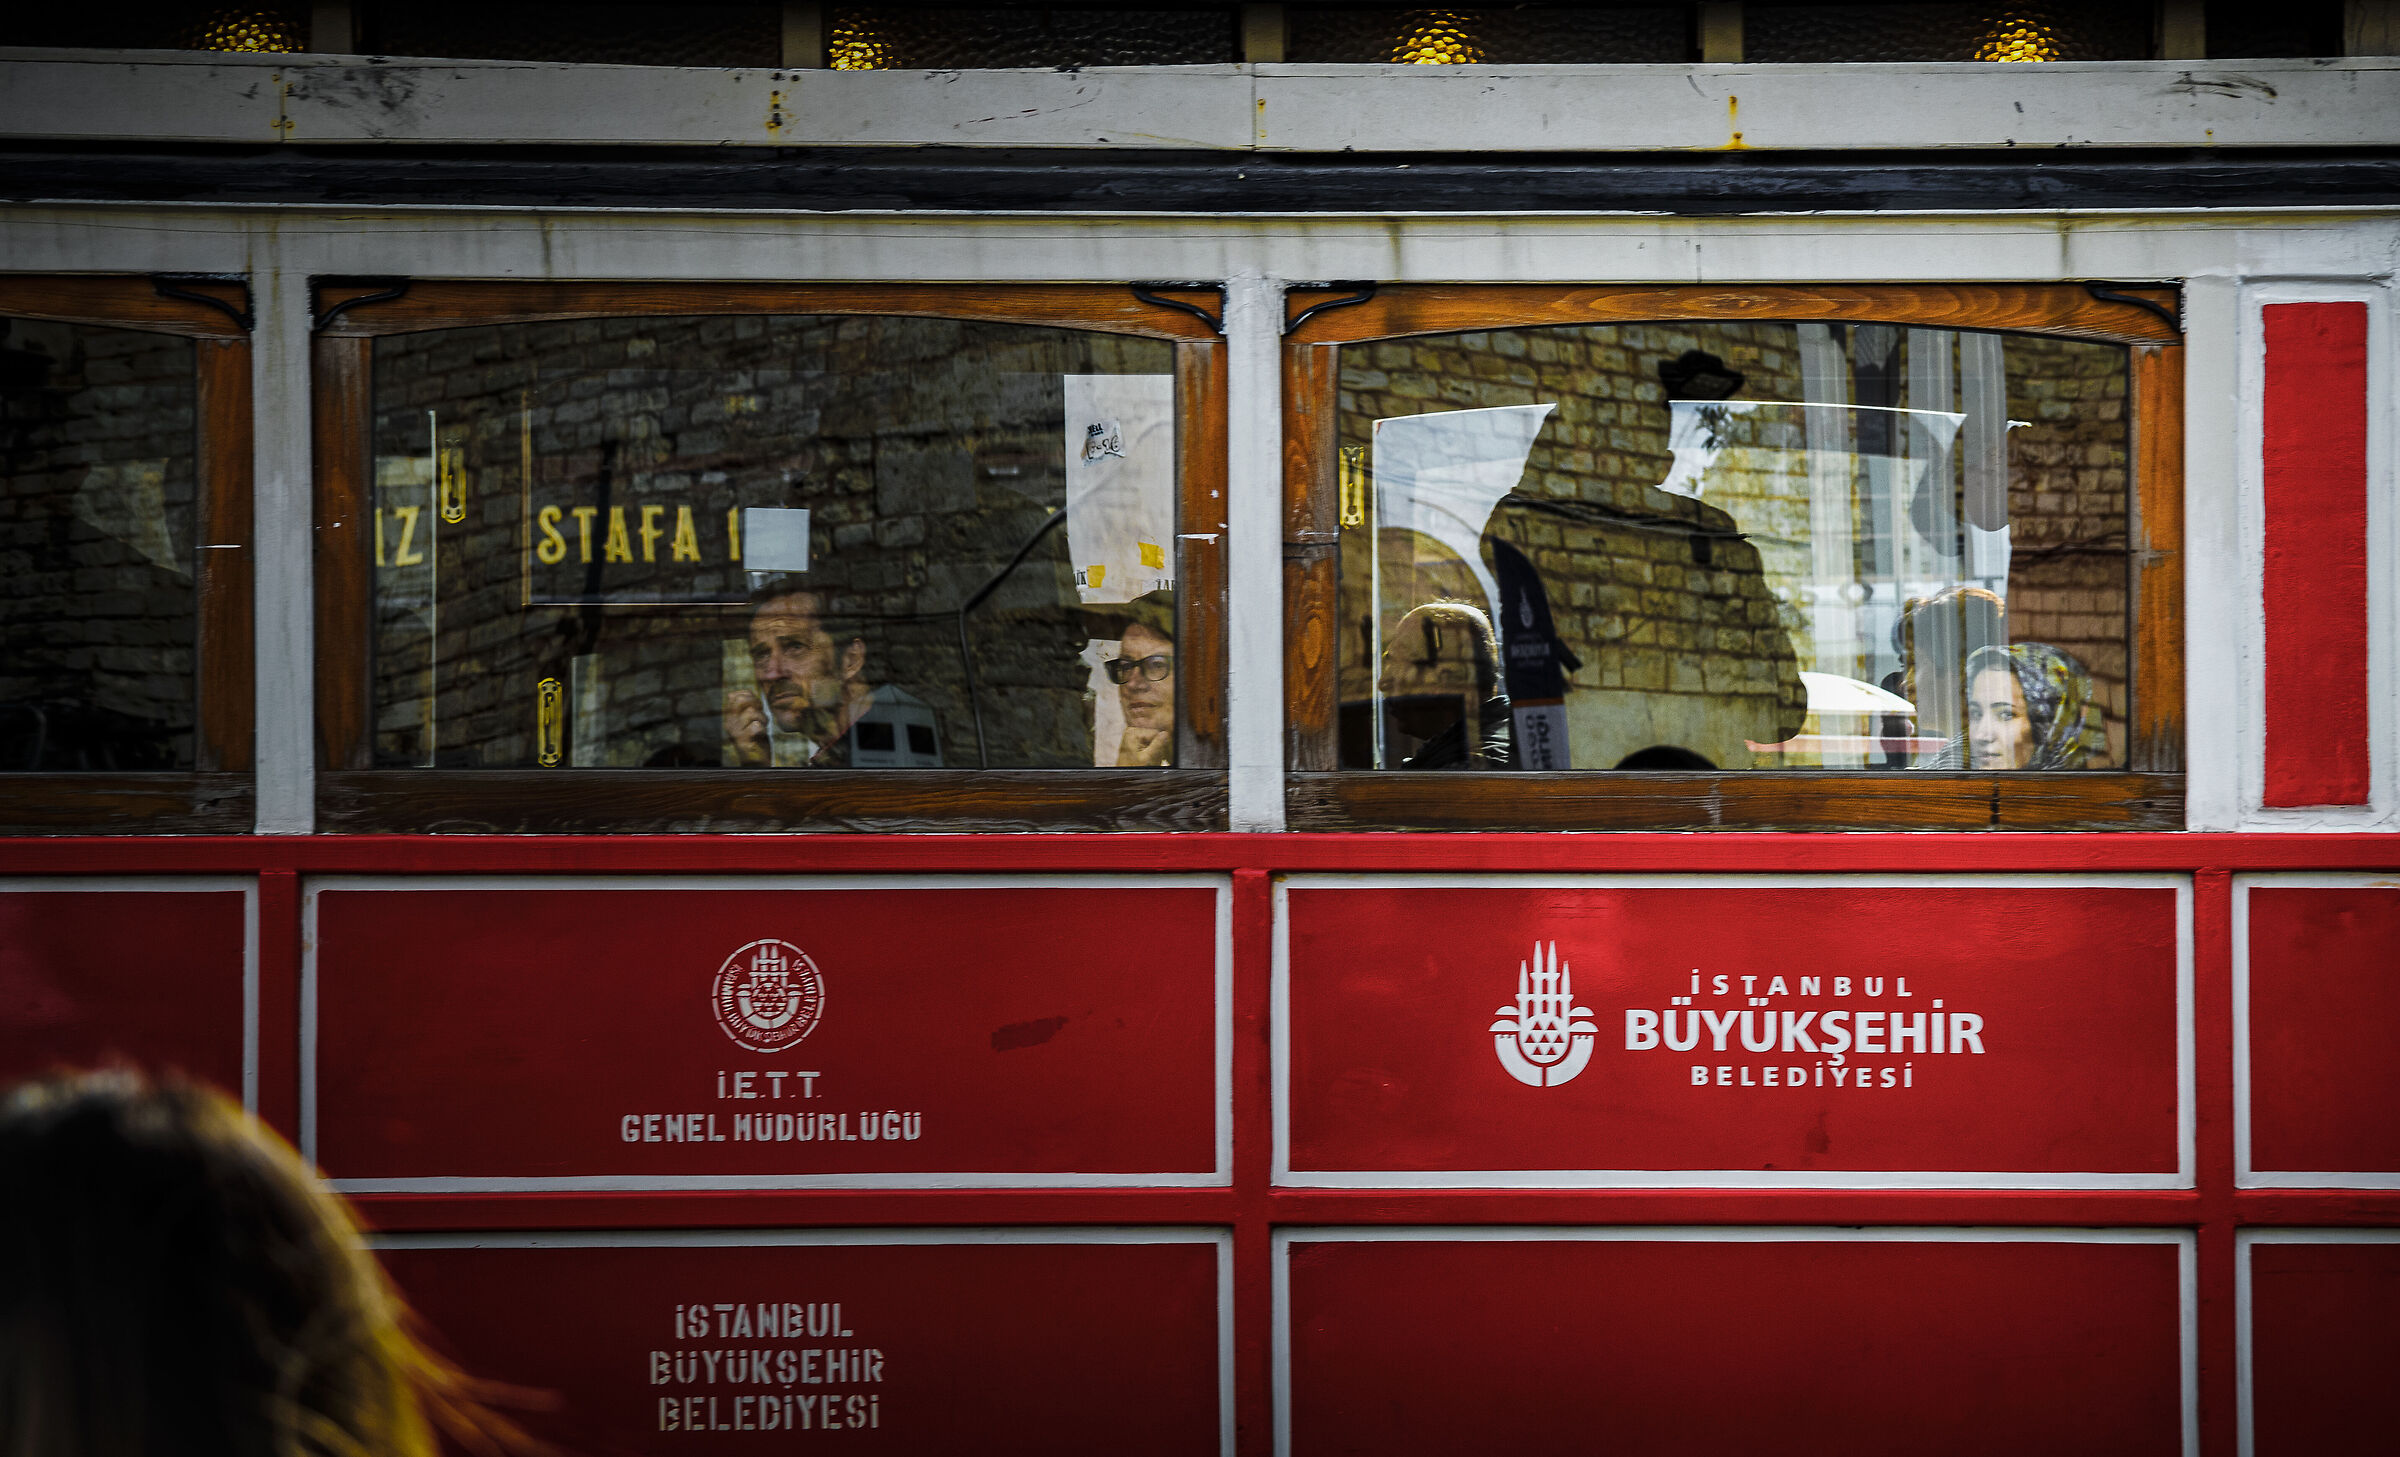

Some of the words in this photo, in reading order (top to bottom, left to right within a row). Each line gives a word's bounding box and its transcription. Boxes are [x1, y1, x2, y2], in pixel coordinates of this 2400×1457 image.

[536, 505, 700, 564] STAFA
[1691, 969, 1912, 997] İSTANBUL
[1624, 996, 1985, 1066] BÜYÜKŞEHİR
[1691, 1061, 1912, 1088] BELEDİYESİ
[621, 1113, 726, 1143] GENEL
[734, 1110, 922, 1142] MÜDÜRLÜĞÜ
[675, 1302, 854, 1340] İSTANBUL
[650, 1348, 885, 1389] BÜYÜKŞEHİR
[659, 1394, 879, 1432] BELEDİYESİ
